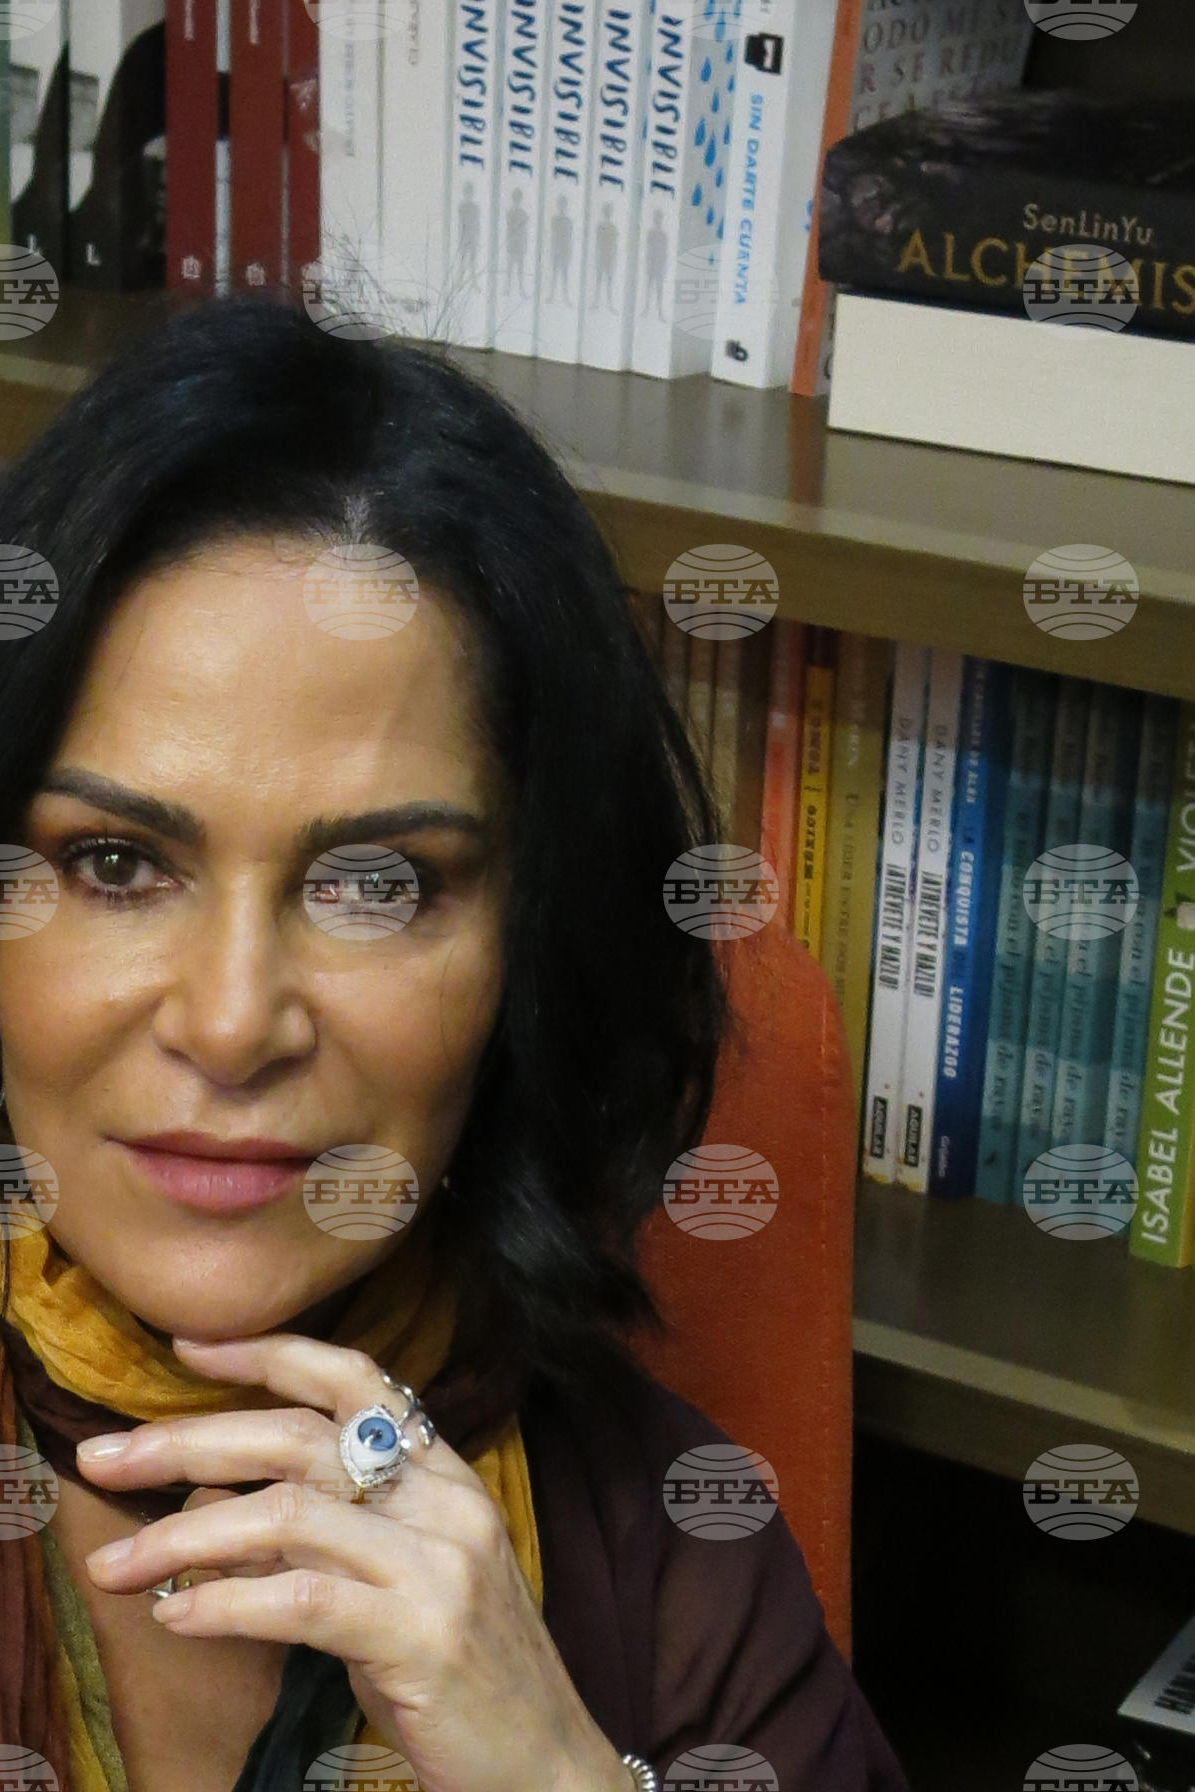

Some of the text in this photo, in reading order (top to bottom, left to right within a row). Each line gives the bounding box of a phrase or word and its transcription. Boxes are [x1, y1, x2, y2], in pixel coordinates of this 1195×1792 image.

[459, 0, 489, 171] NVISIBLE
[554, 3, 586, 185] INVISIBLE
[599, 9, 632, 192] INVISIBLE
[650, 14, 684, 200] INVISIBLE
[734, 93, 764, 304] SIN DARTE CUENTA
[1022, 202, 1155, 246] SenLinYu
[897, 717, 914, 772] DANY
[931, 724, 947, 780] DANY
[892, 780, 906, 845] MERLO
[926, 789, 943, 853] MERLO
[953, 851, 975, 946] CONQUISTA
[943, 986, 964, 1079] LIDERAZGO
[1141, 947, 1195, 1245] ISABEL ALLENDE
